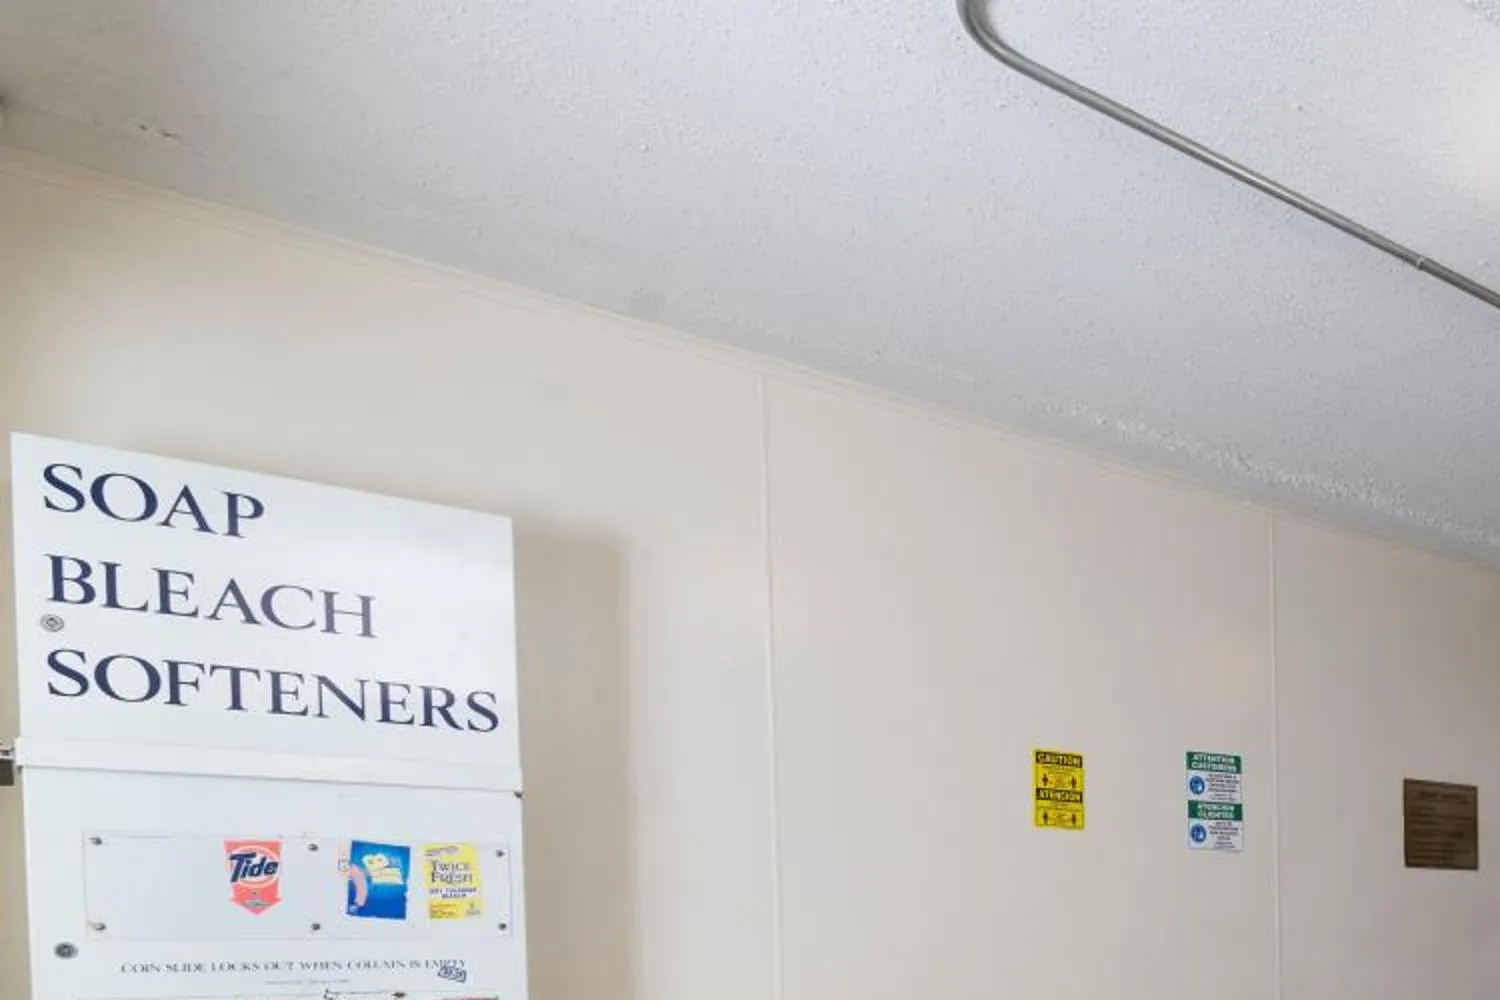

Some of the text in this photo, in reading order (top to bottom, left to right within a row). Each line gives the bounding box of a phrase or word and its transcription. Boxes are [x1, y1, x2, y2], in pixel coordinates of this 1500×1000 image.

[43, 463, 265, 538] SOAP
[45, 553, 377, 638] BLEACH
[47, 648, 499, 733] SOFTENERS
[1038, 753, 1080, 766] CAUTION
[229, 851, 279, 883] Tide
[430, 860, 471, 873] TWICE
[121, 962, 161, 973] COIN
[165, 962, 208, 973] SLIDE
[210, 961, 260, 972] LOCKS
[263, 960, 294, 971] OUT
[300, 960, 343, 970] WHEN
[409, 959, 421, 969] IS
[425, 959, 466, 969] EMPTY
